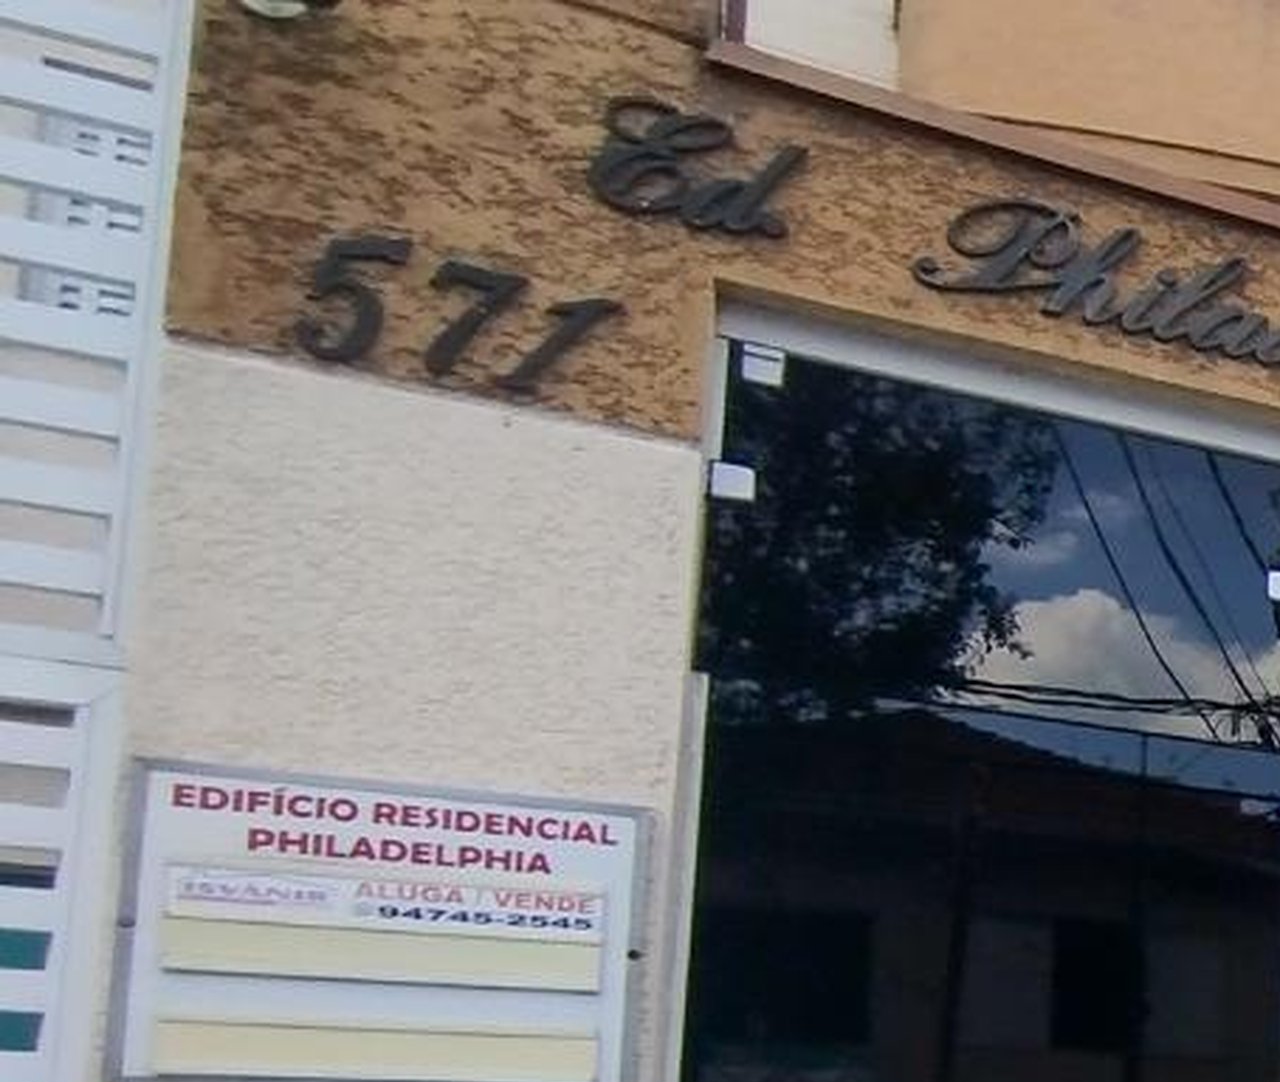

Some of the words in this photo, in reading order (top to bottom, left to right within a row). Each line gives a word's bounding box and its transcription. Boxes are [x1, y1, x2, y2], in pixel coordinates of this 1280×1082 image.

[295, 233, 628, 396] 571
[171, 783, 359, 822] EDIFÍCIO
[373, 802, 619, 846] RESIDENCIAL
[247, 828, 551, 875] PHILADELPHIA
[355, 881, 463, 904] ALUGA
[495, 890, 596, 915] VENDE
[378, 904, 594, 931] 94745-2545
